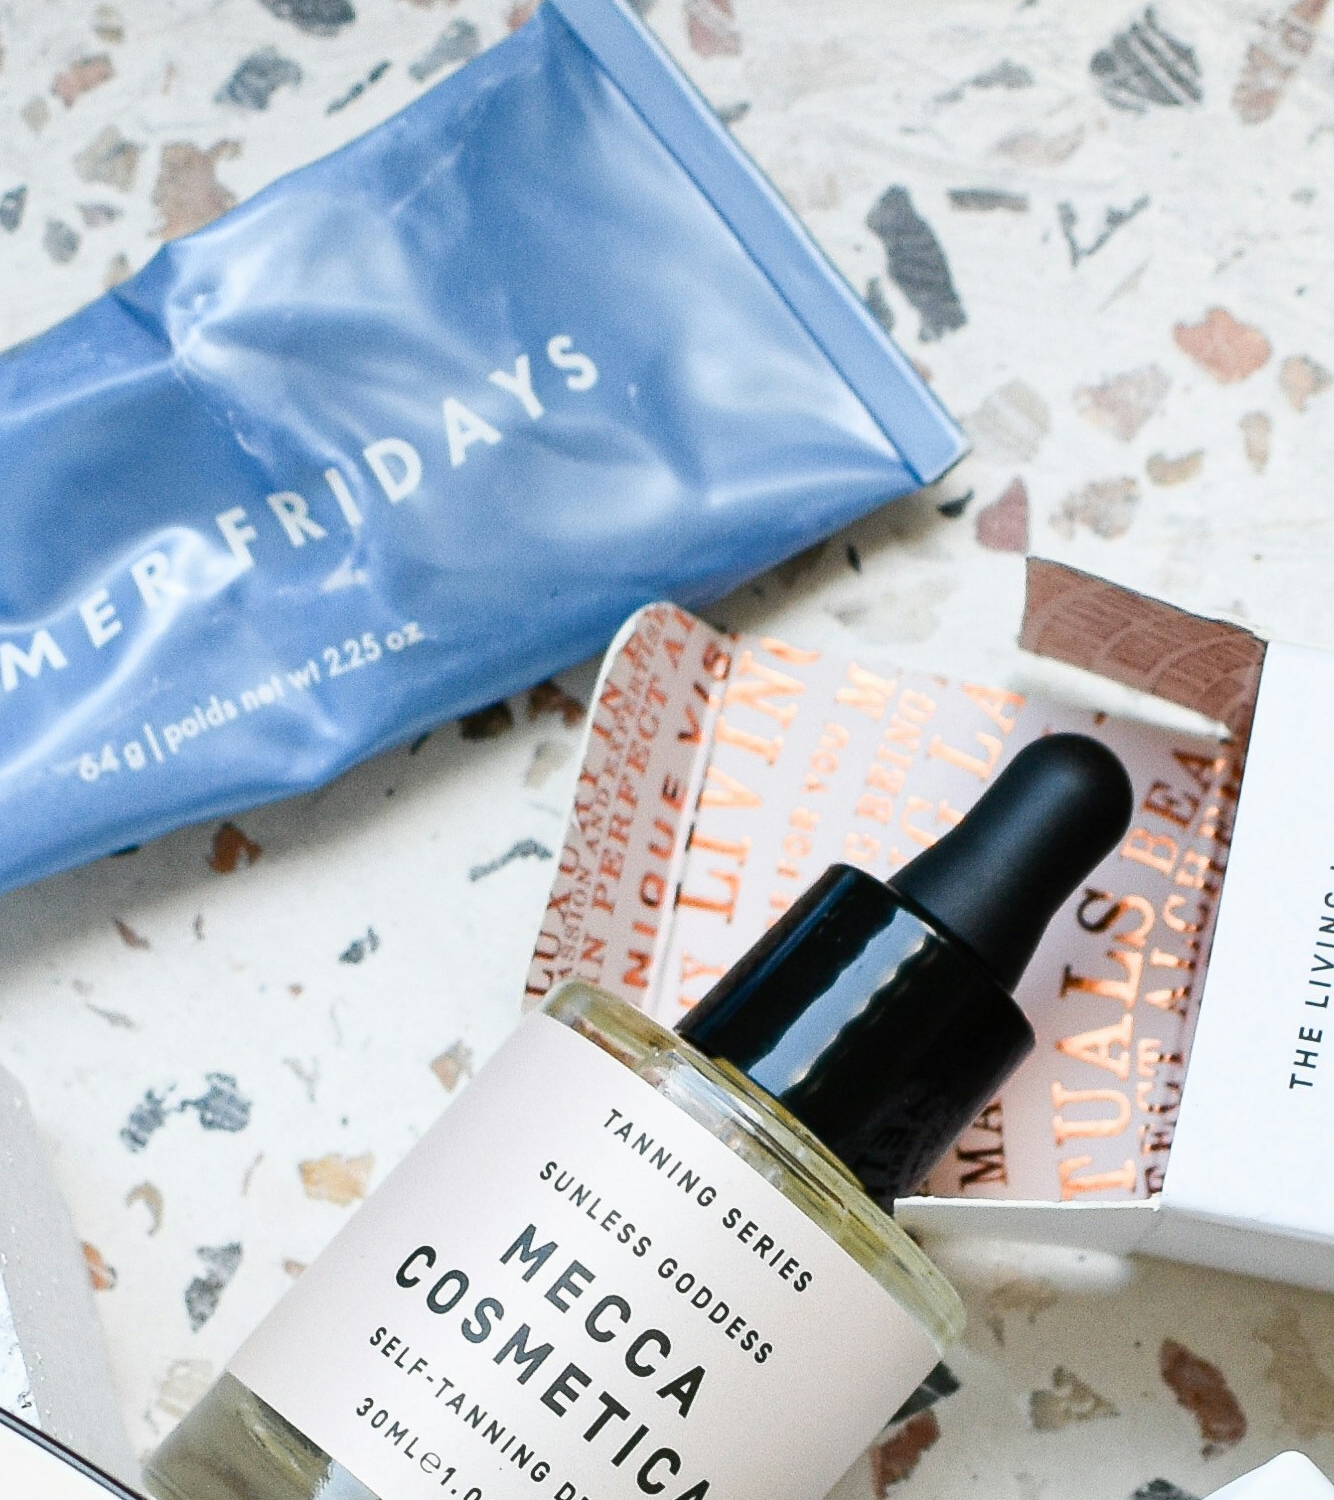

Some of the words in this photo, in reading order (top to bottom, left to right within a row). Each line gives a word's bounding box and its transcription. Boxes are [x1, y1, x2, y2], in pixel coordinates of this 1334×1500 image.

[215, 333, 600, 574] FRIDAYS
[77, 743, 121, 784] 64
[161, 693, 240, 756] poids
[240, 672, 286, 715] net
[287, 658, 323, 693] wt
[322, 631, 384, 680] 2.25
[384, 620, 426, 654] oz
[590, 674, 668, 917] PERFECT
[1287, 1025, 1323, 1090] THE
[538, 1160, 654, 1258] SUNLESS
[656, 1256, 774, 1365] GODDESS
[602, 1107, 718, 1209] TANNING
[721, 1206, 814, 1295] SERIES
[368, 1325, 552, 1484] SELF-TANNING
[498, 1223, 708, 1420] MECCA
